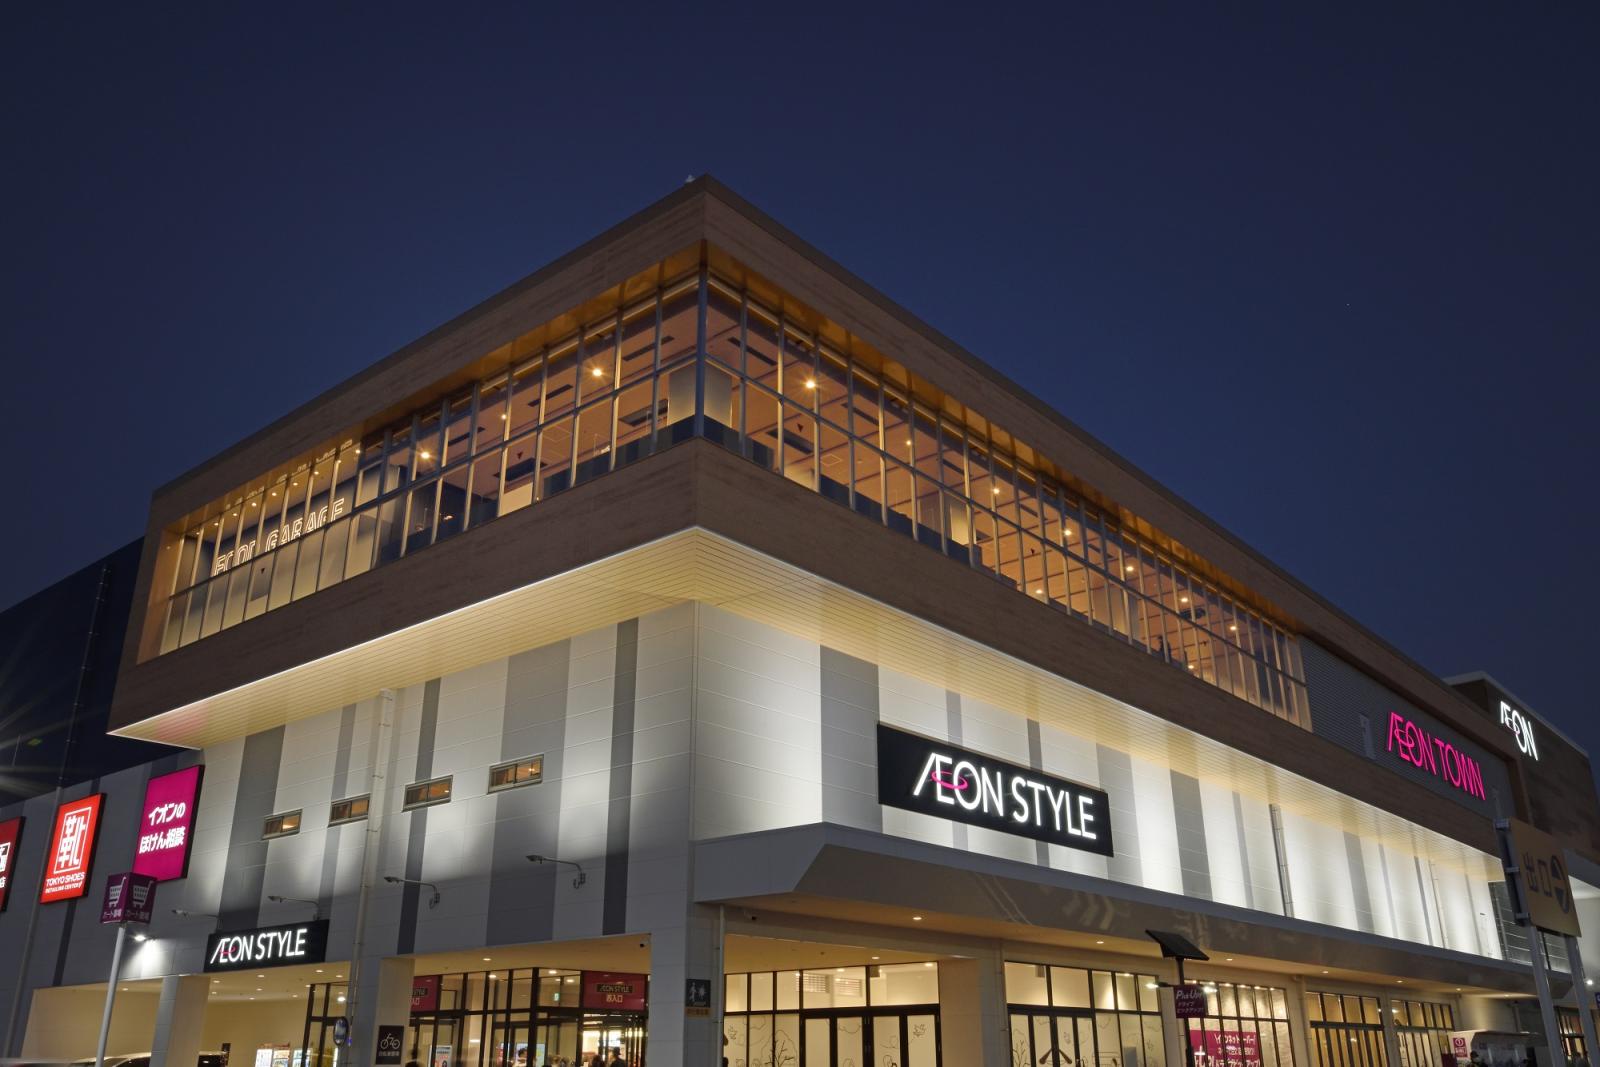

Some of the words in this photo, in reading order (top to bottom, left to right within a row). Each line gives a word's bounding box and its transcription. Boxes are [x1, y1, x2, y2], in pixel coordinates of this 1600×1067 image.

[1434, 738, 1486, 800] TOWN
[148, 802, 186, 826] イオンの
[1011, 776, 1097, 840] STYLE
[139, 826, 186, 854] ほけん相談
[46, 875, 65, 887] TOKYO
[64, 872, 86, 884] SHOES
[255, 928, 308, 960] STYLE
